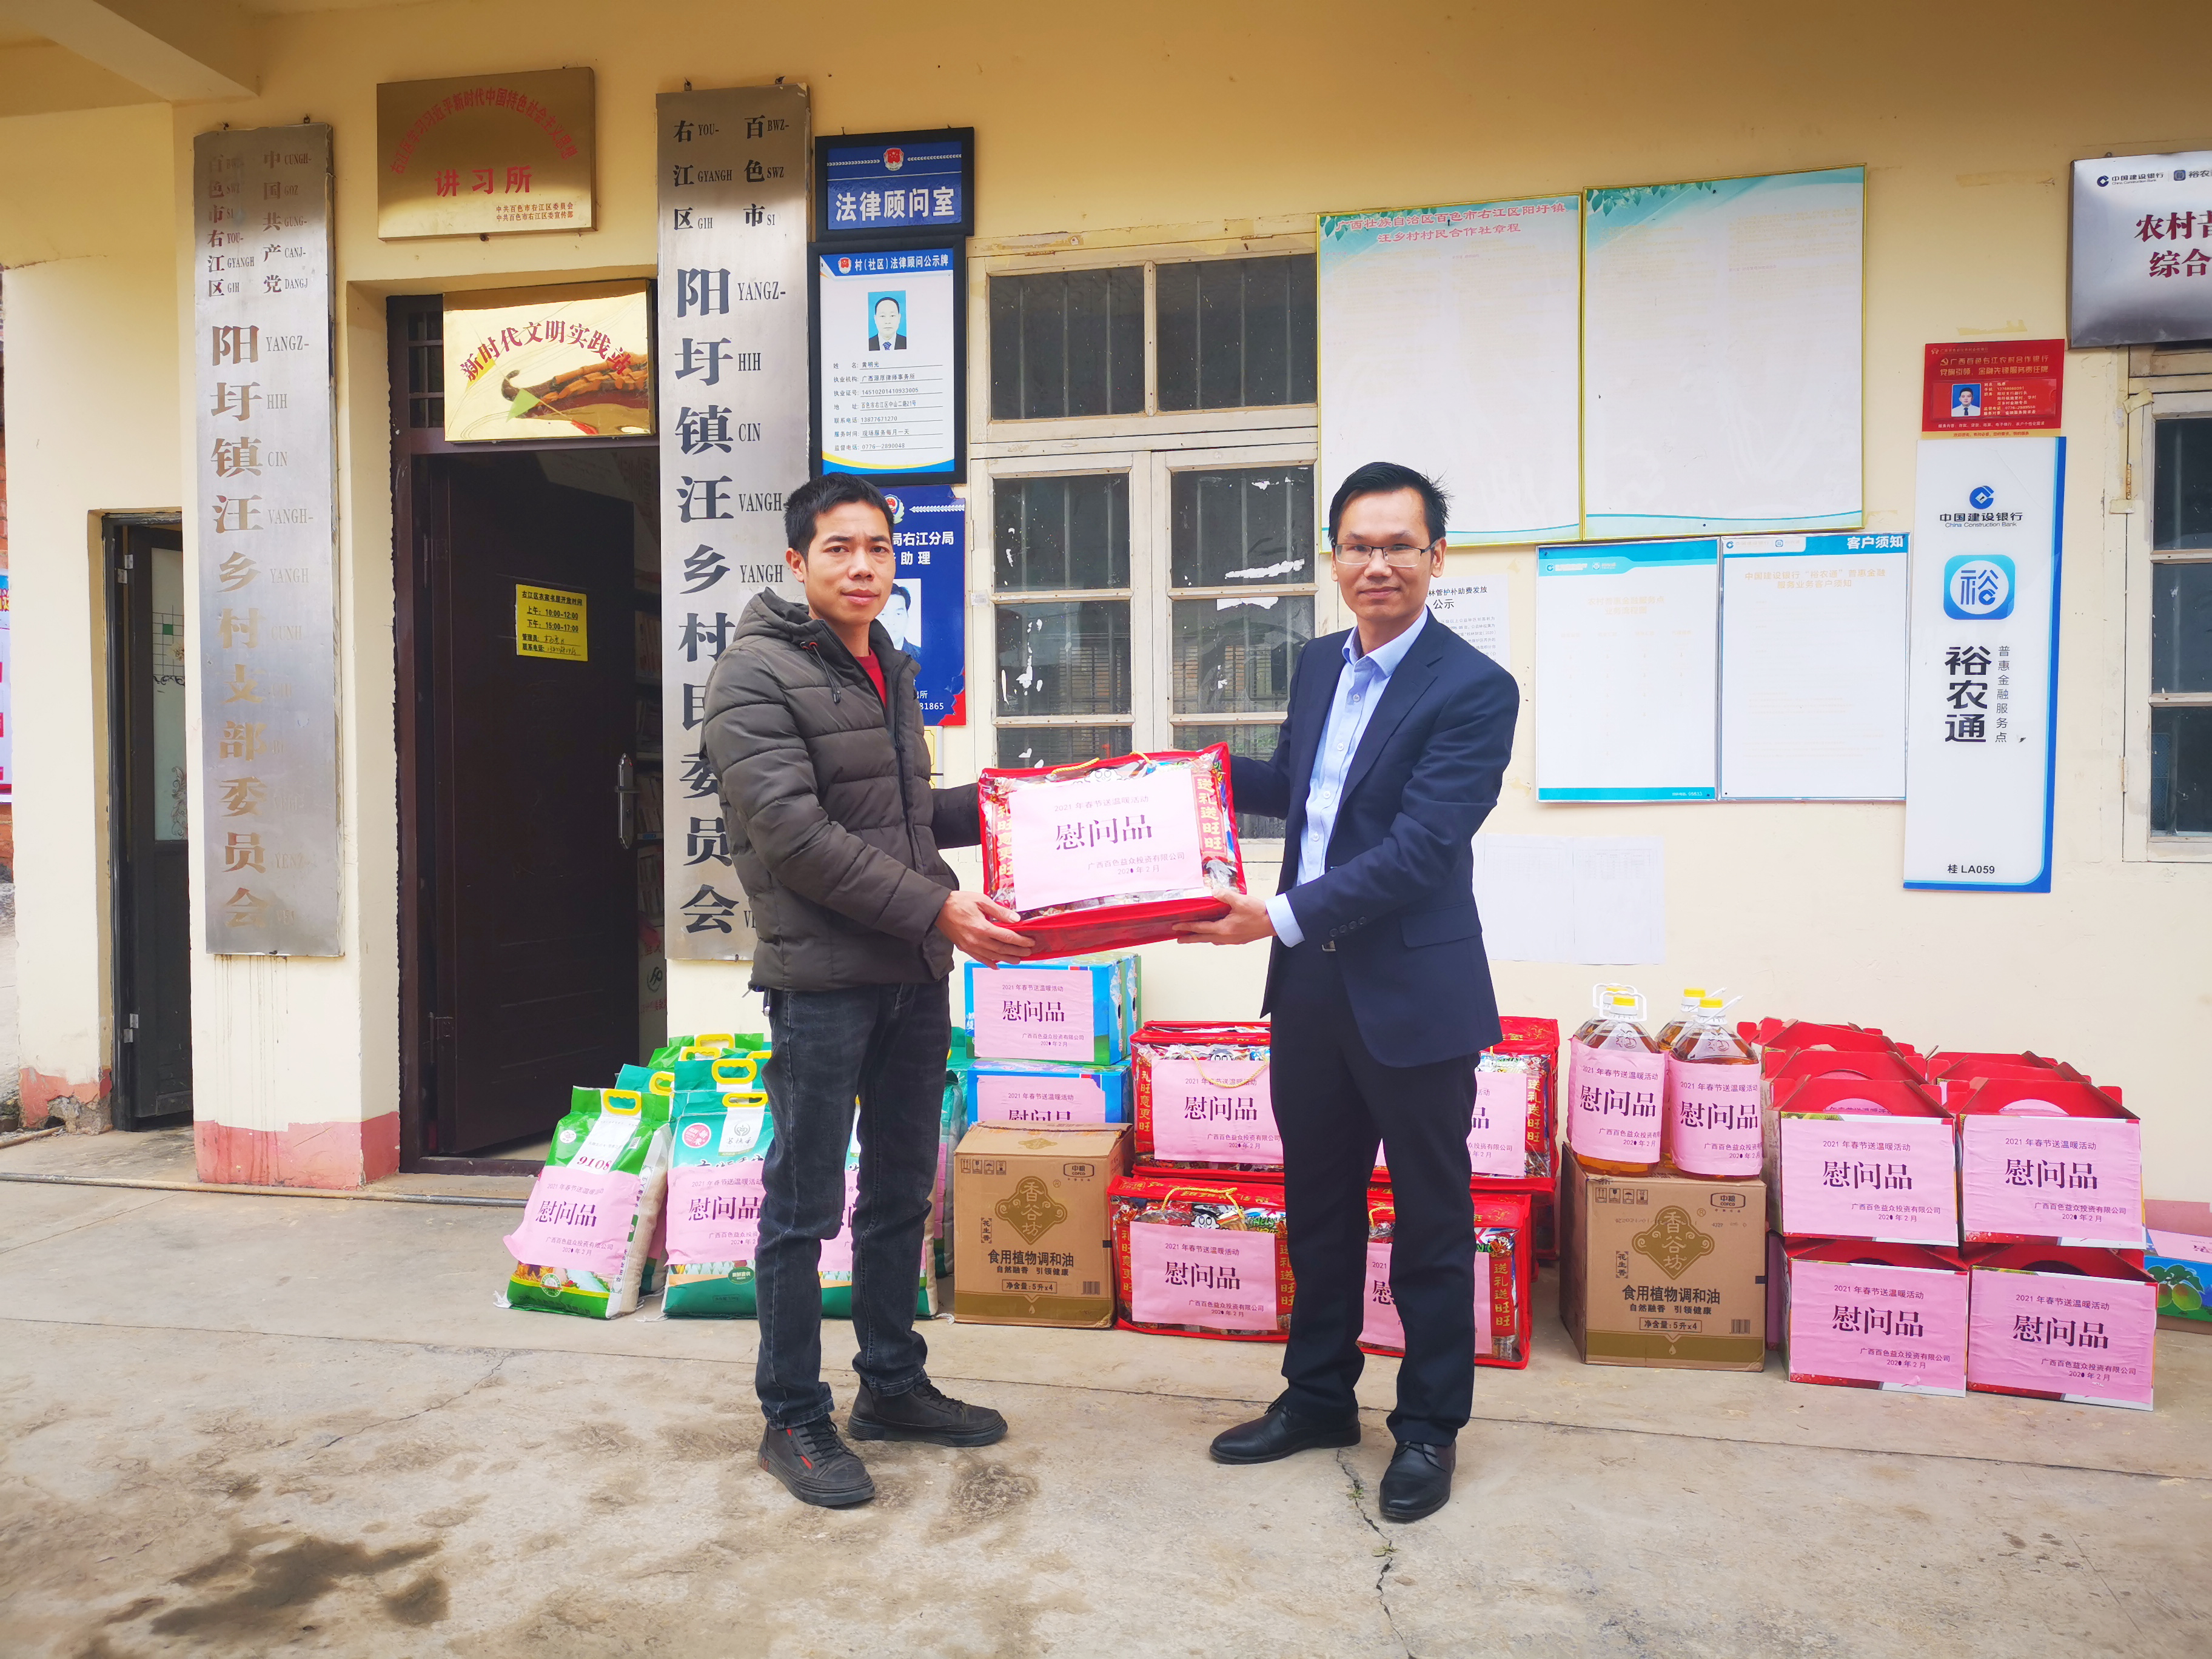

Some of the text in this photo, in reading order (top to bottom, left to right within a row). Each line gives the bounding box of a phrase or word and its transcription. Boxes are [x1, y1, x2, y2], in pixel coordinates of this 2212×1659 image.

[434, 164, 533, 198] 讲习所
[672, 119, 695, 230] 右江区
[697, 169, 732, 183] GYANGH
[743, 115, 766, 228] 百色市
[767, 166, 784, 179] SWZ
[2112, 172, 2164, 181] 中国建设银行
[495, 202, 574, 213] 中共百色市右江区委员会
[836, 186, 955, 222] 法律顾问室
[263, 150, 283, 294] 中国共产党
[495, 210, 574, 222] 中共百色市右江区委宣传部
[697, 217, 713, 230] GIH
[767, 214, 775, 226] SI
[1336, 203, 1566, 232] 广西壮族自治区百色市右江区阳圩镇
[1378, 223, 1521, 243] 汪乡村村民合作社章程
[227, 256, 255, 268] GYANGH
[2149, 248, 2212, 278] 综合
[227, 283, 240, 293] GIH
[285, 278, 308, 289] DANGJ
[460, 320, 631, 381] 新时代文明实践站
[738, 353, 761, 371] HIH
[267, 394, 287, 409] HIH
[739, 423, 760, 442] CIN
[268, 451, 287, 467] CIN
[1940, 512, 2023, 522] 中国建设银行
[1846, 535, 1904, 550] 客户须知
[894, 551, 931, 566] 助理
[270, 568, 309, 583] YANGH
[740, 565, 783, 583] YANGH
[1777, 580, 1852, 589] 服务业务客户须知
[1427, 586, 1487, 597] 林管护补助费发放
[1433, 599, 1454, 609] 公示
[210, 325, 269, 928] 阳圩镇汪乡村支部委员会
[1944, 645, 1992, 743] 裕农通
[1995, 645, 2011, 743] 普惠金融服务点
[1197, 777, 1223, 851] 送礼送旺旺
[1056, 814, 1152, 851] 慰问品
[1002, 1000, 1065, 1022] 慰问品
[1139, 1070, 1151, 1132] 礼旺意更旺
[1184, 1096, 1257, 1121] 慰问品
[1527, 1079, 1541, 1143] 送礼送旺旺
[1580, 1085, 1656, 1118] 慰问品
[1680, 1101, 1758, 1130] 慰问品
[577, 1155, 612, 1170] 9108
[1823, 1161, 1912, 1190] 慰问品
[2005, 1159, 2097, 1190] 慰问品
[535, 1201, 597, 1227] 慰问品
[688, 1196, 761, 1221] 慰问品
[1021, 1182, 1044, 1236] 香谷坊
[1662, 1212, 1687, 1270] 香谷坊
[988, 1249, 1074, 1267] 食用植物调和油
[997, 1265, 1069, 1276] 自然融香 引领健康
[1165, 1261, 1240, 1290] 慰问品
[1494, 1262, 1511, 1327] 送礼送旺旺
[1622, 1284, 1720, 1304] 食用植物调和油
[1630, 1304, 1712, 1315] 自然融香 引领健康
[1832, 1304, 1923, 1338] 慰问品
[2013, 1315, 2108, 1349] 慰问品
